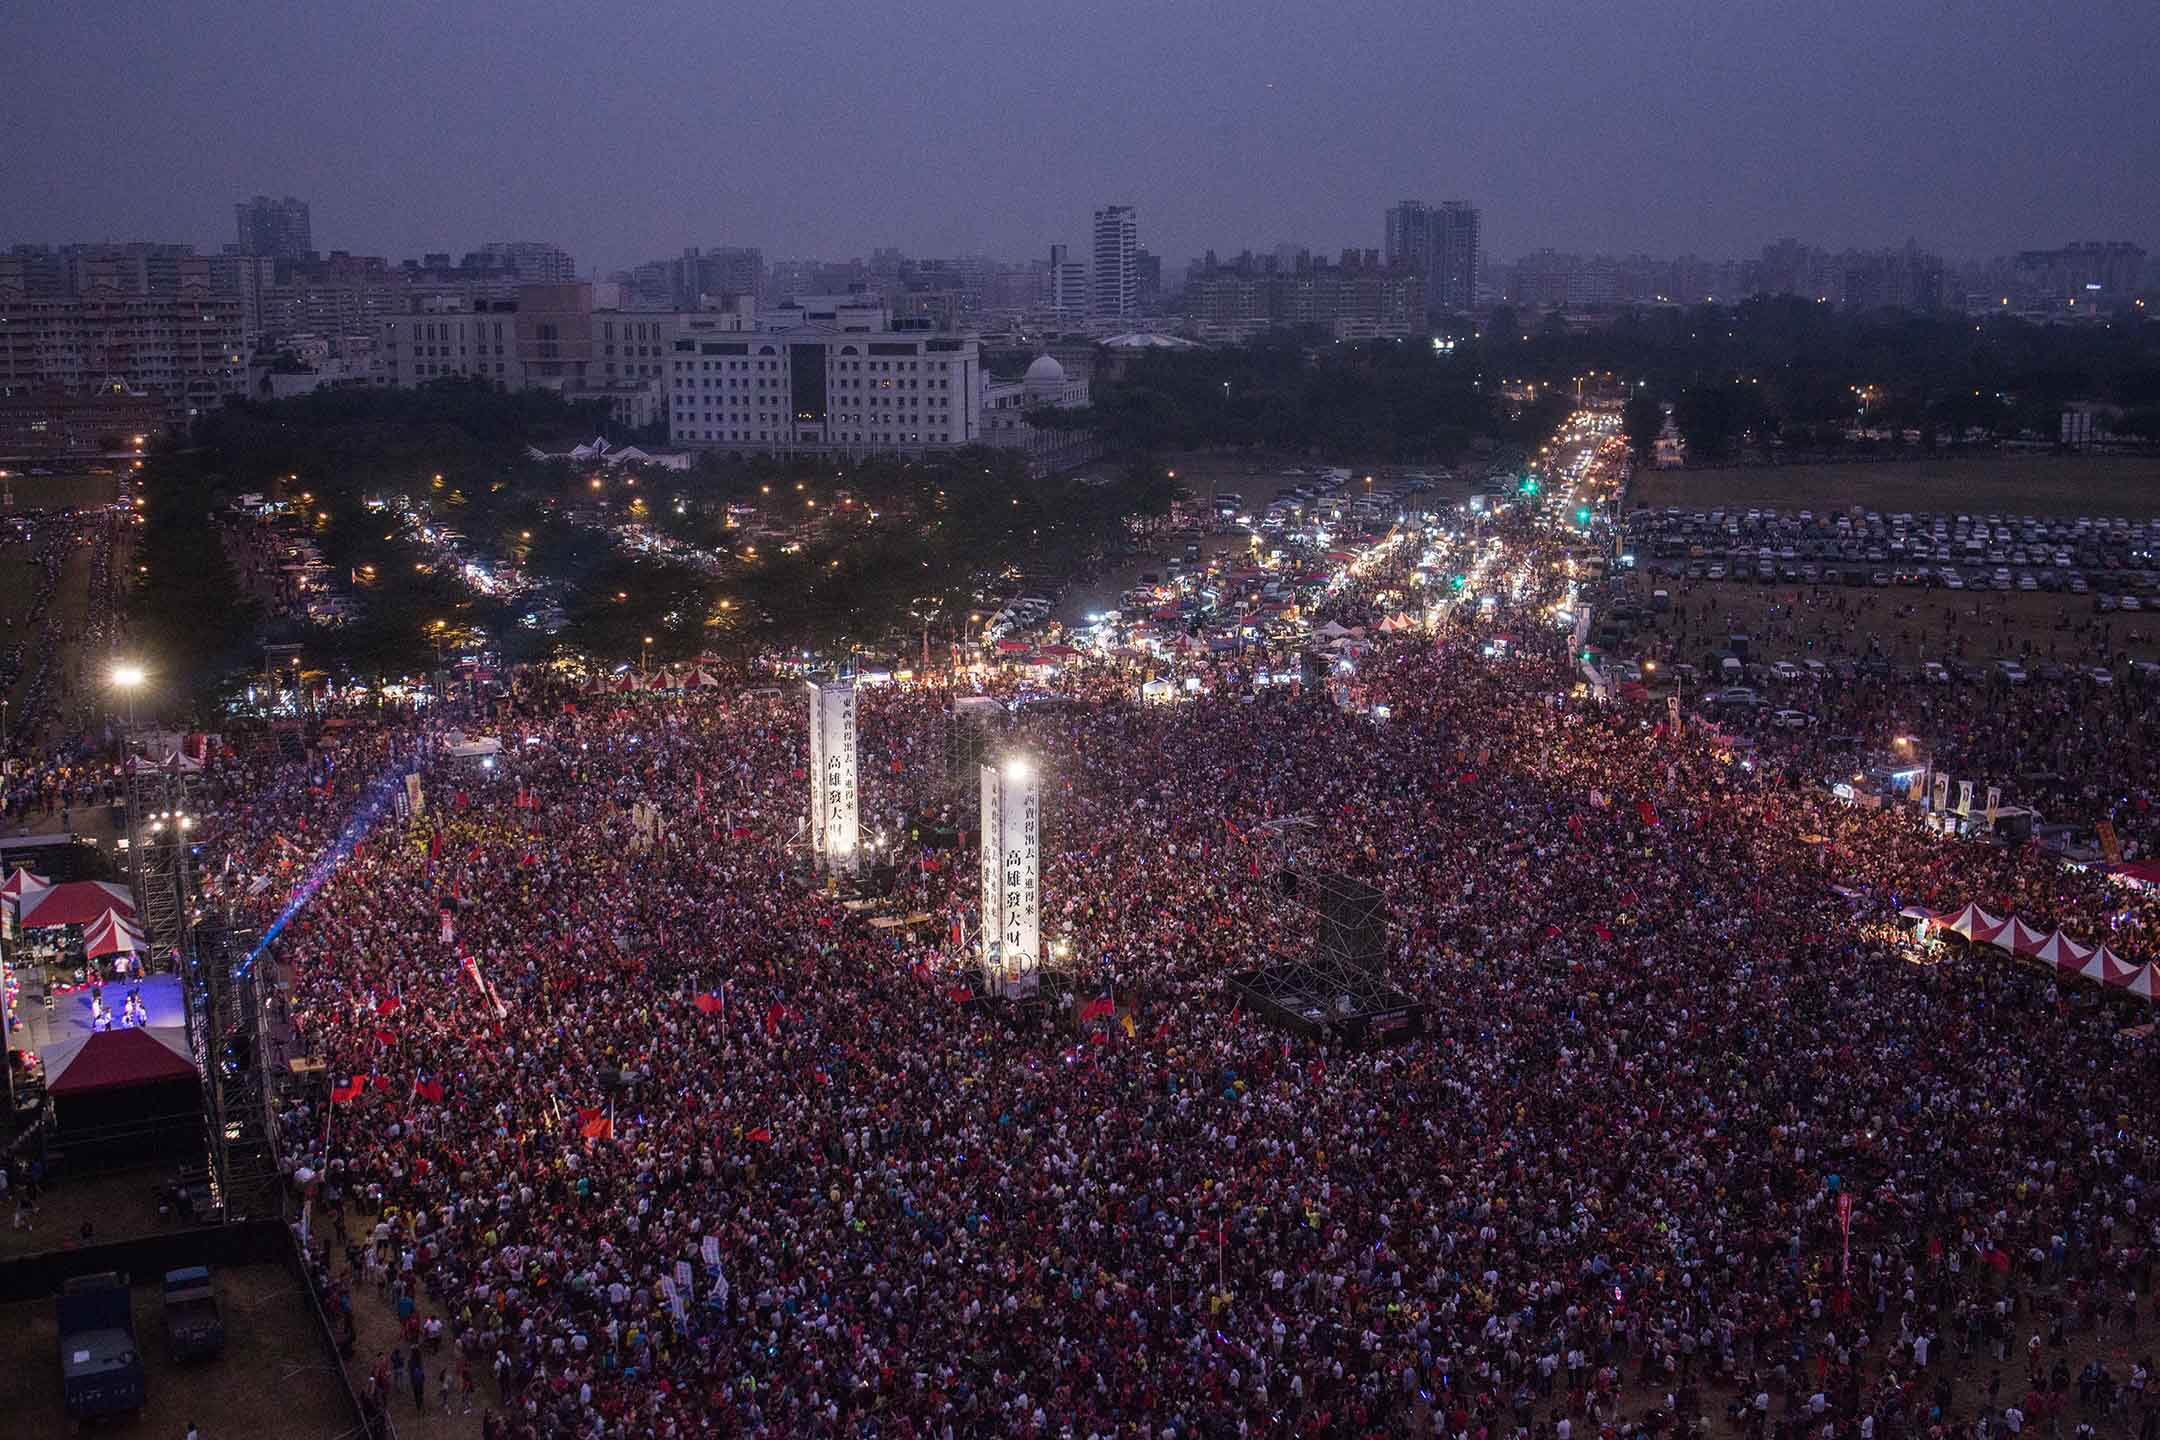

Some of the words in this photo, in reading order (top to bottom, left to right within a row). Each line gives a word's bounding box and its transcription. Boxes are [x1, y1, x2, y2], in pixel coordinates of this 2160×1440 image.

[1006, 849, 1021, 948] 高雄發大財
